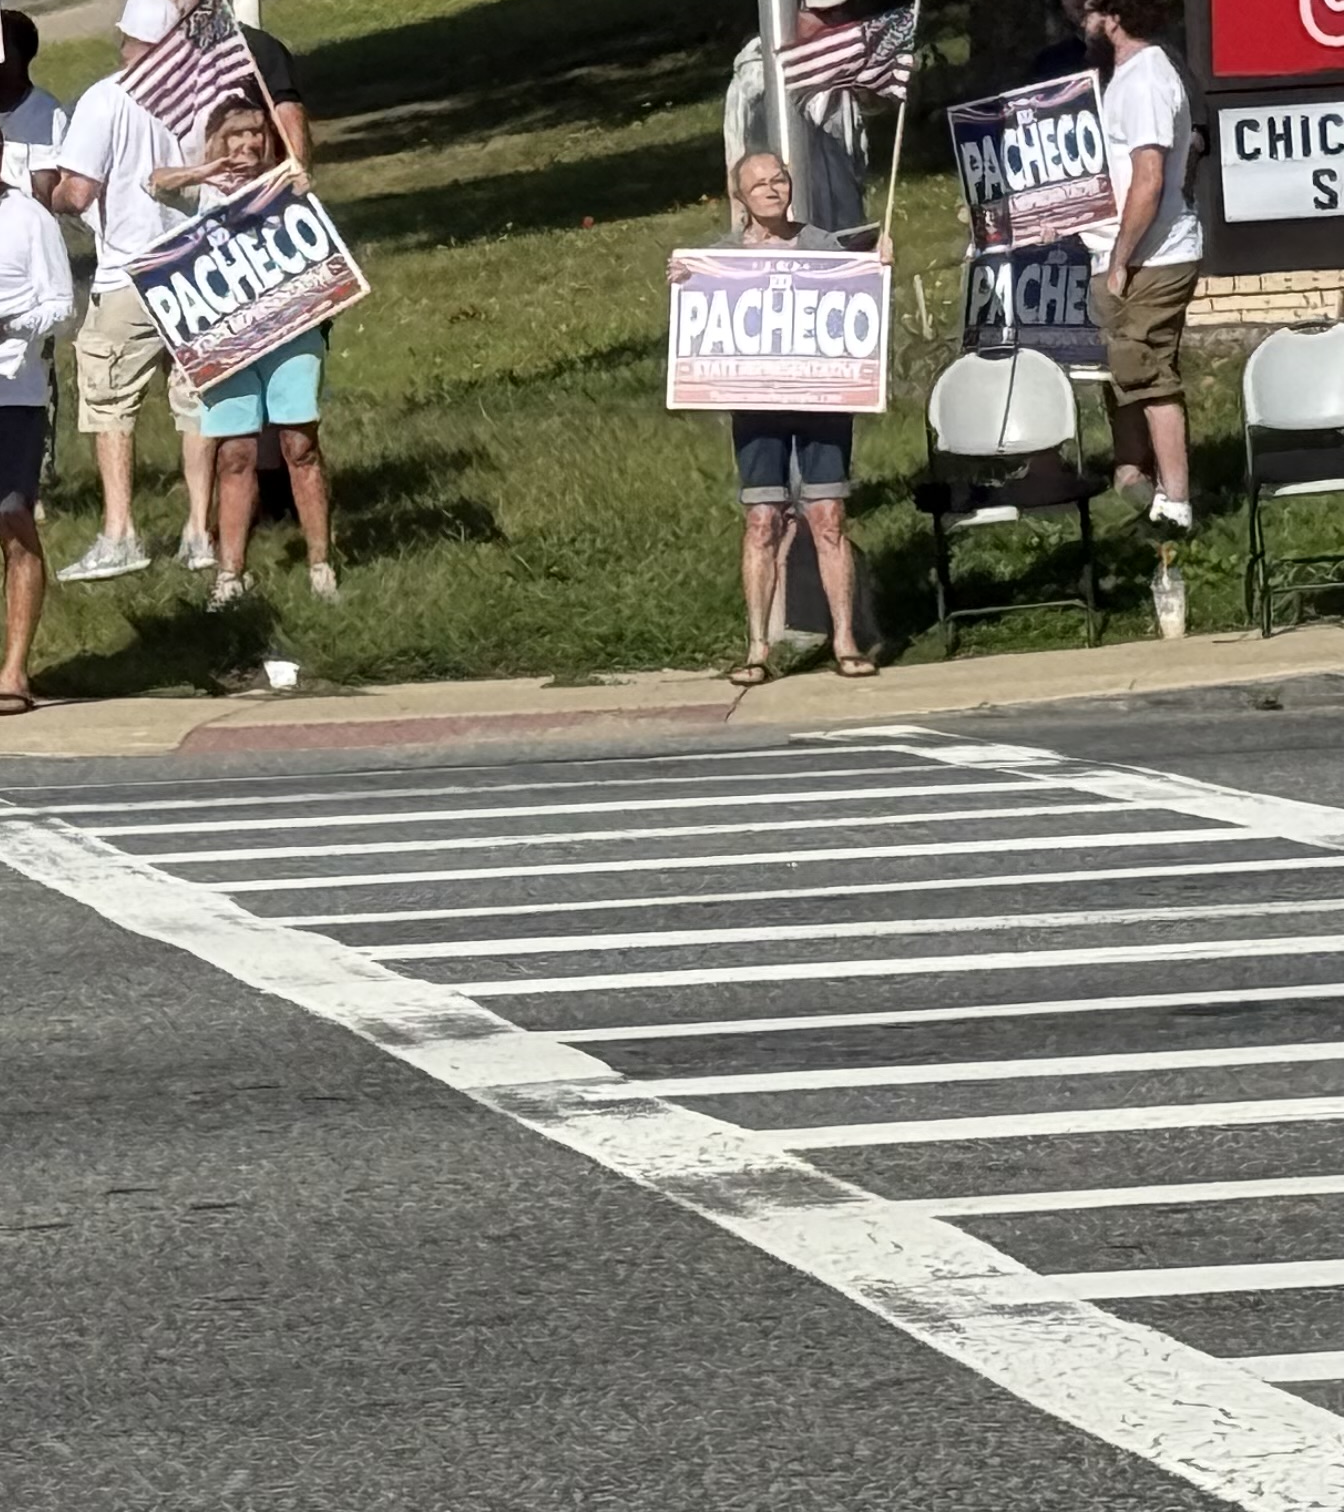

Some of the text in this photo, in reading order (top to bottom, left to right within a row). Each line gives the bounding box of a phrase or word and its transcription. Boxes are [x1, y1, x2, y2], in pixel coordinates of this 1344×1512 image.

[960, 110, 1104, 205] PACHECO
[1234, 113, 1344, 161] CHIC
[145, 204, 330, 347] PACHECO
[968, 263, 1089, 326] PACHE
[678, 287, 880, 358] PACHECO
